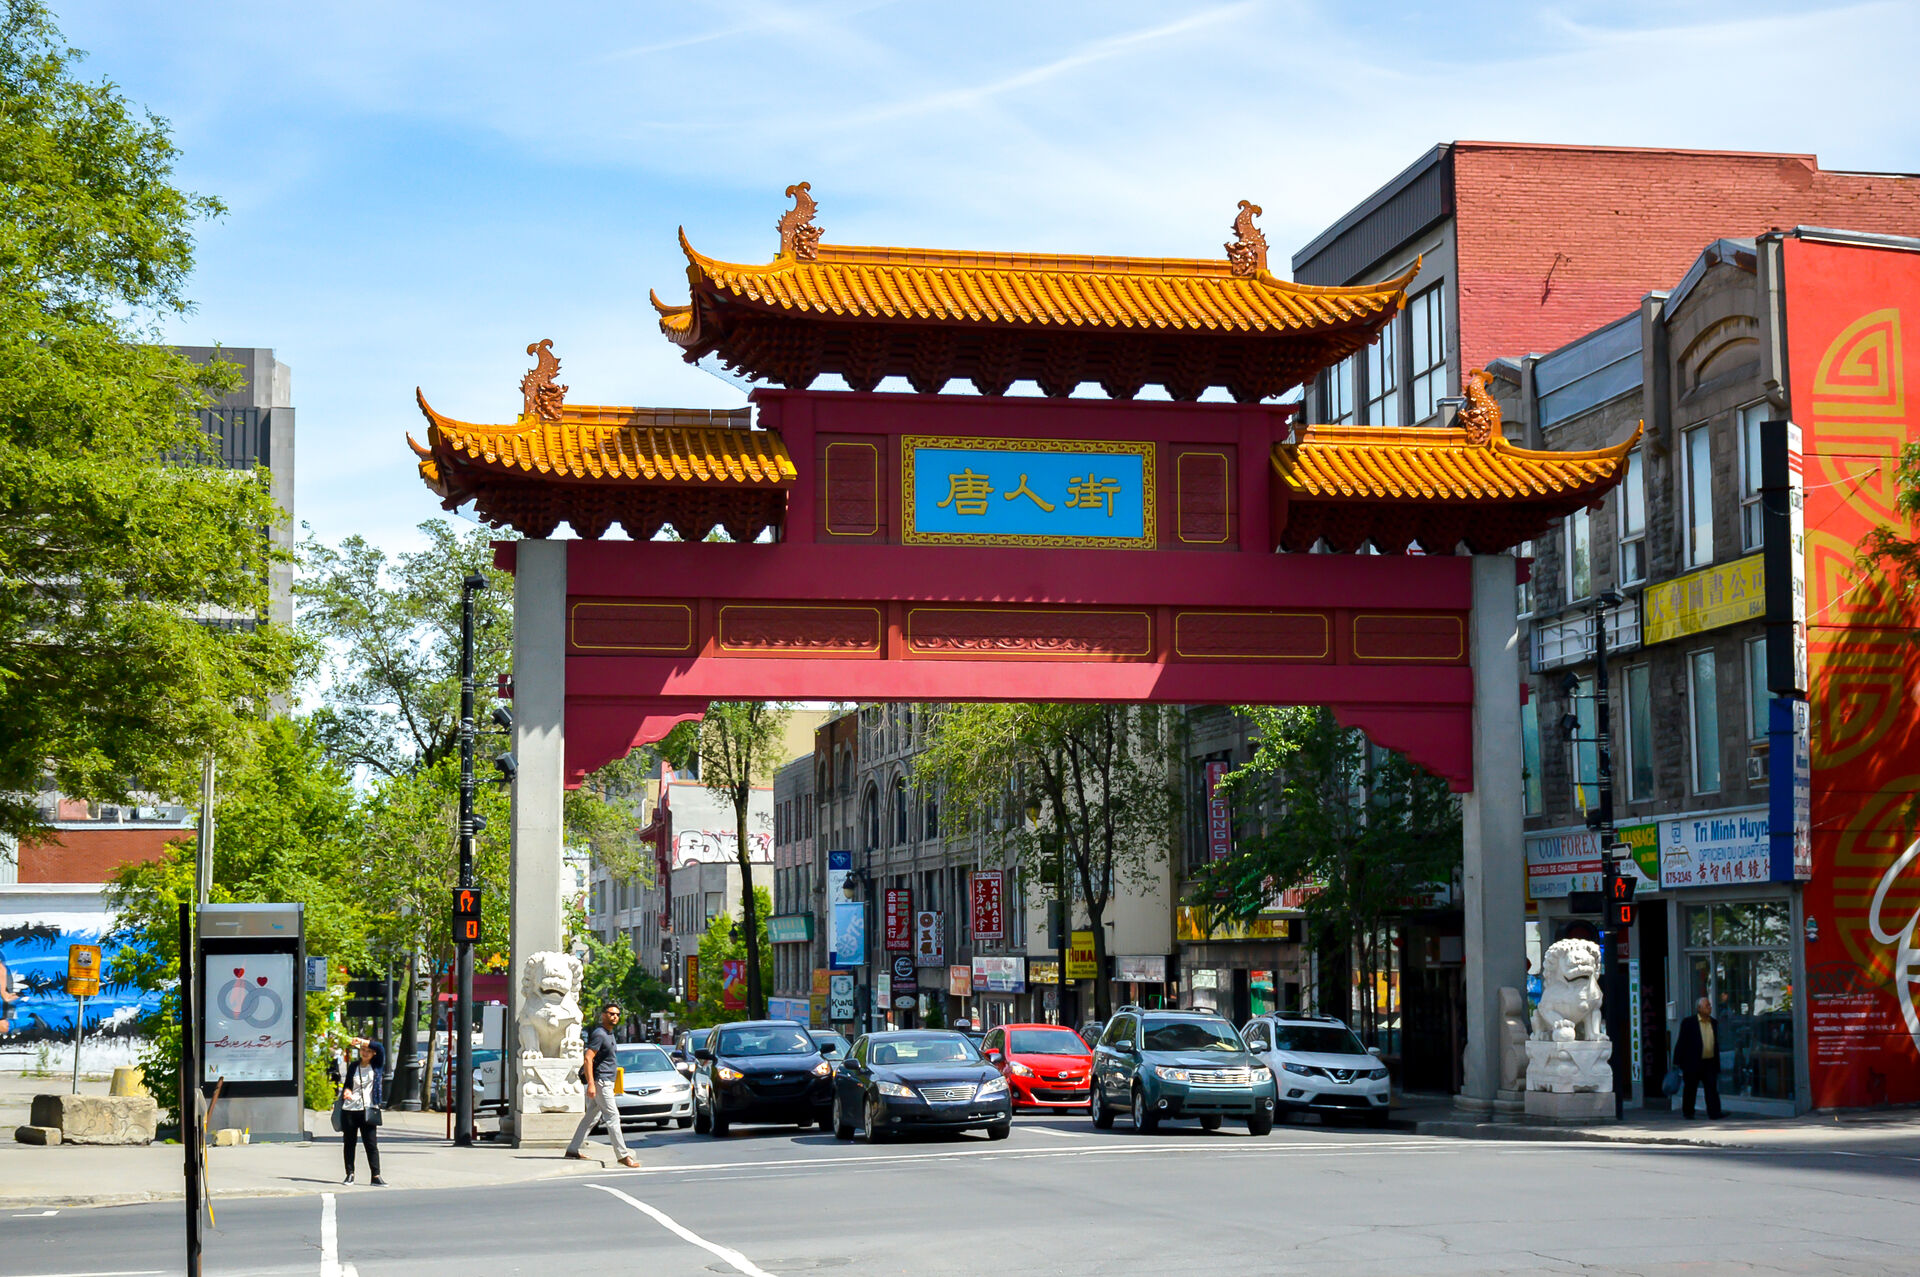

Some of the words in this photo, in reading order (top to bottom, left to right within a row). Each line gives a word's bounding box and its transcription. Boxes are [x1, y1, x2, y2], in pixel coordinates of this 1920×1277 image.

[937, 467, 1121, 517] 唐人街
[1212, 799, 1226, 839] FUNG
[1620, 827, 1657, 848] MASSAGE
[1694, 822, 1707, 842] Tri
[1711, 819, 1736, 841] Minh
[1539, 833, 1598, 859] COMFOREX
[1728, 846, 1736, 859] DU
[1550, 865, 1557, 873] DE
[990, 880, 1000, 931] MASSAGE
[831, 999, 853, 1008] KUNG
[837, 1007, 849, 1017] FU
[1631, 983, 1639, 1062] MASSAGE
[215, 1035, 241, 1048] Love
[256, 1035, 284, 1048] Love
